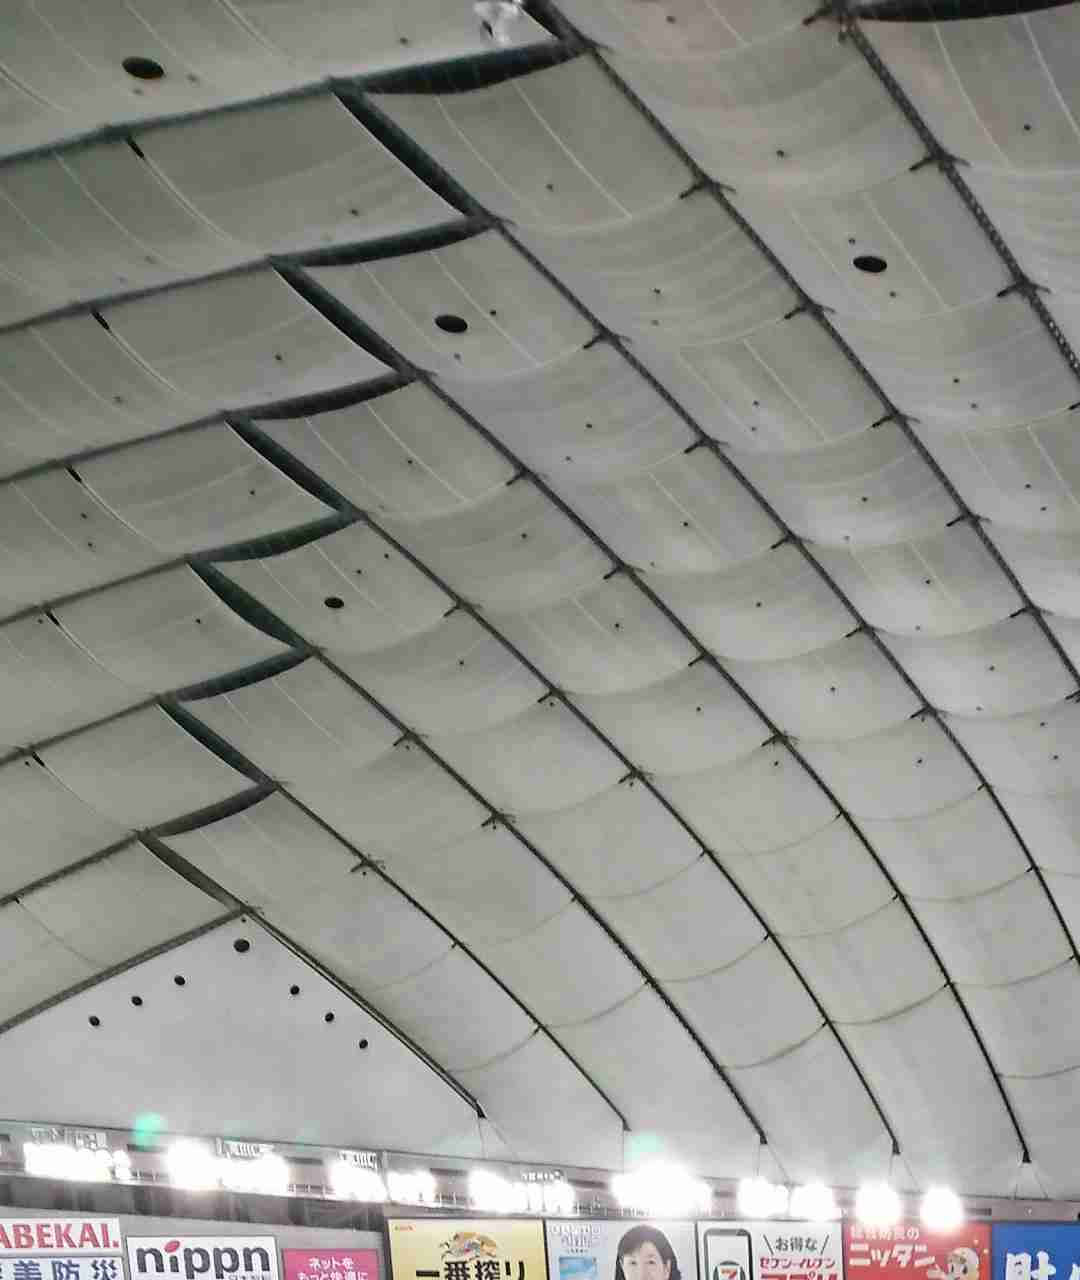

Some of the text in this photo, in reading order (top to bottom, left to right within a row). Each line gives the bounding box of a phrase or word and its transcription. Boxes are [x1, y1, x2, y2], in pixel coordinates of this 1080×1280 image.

[775, 1237, 818, 1252] お得な
[136, 1240, 271, 1279] nippn
[309, 1257, 353, 1270] ネットを
